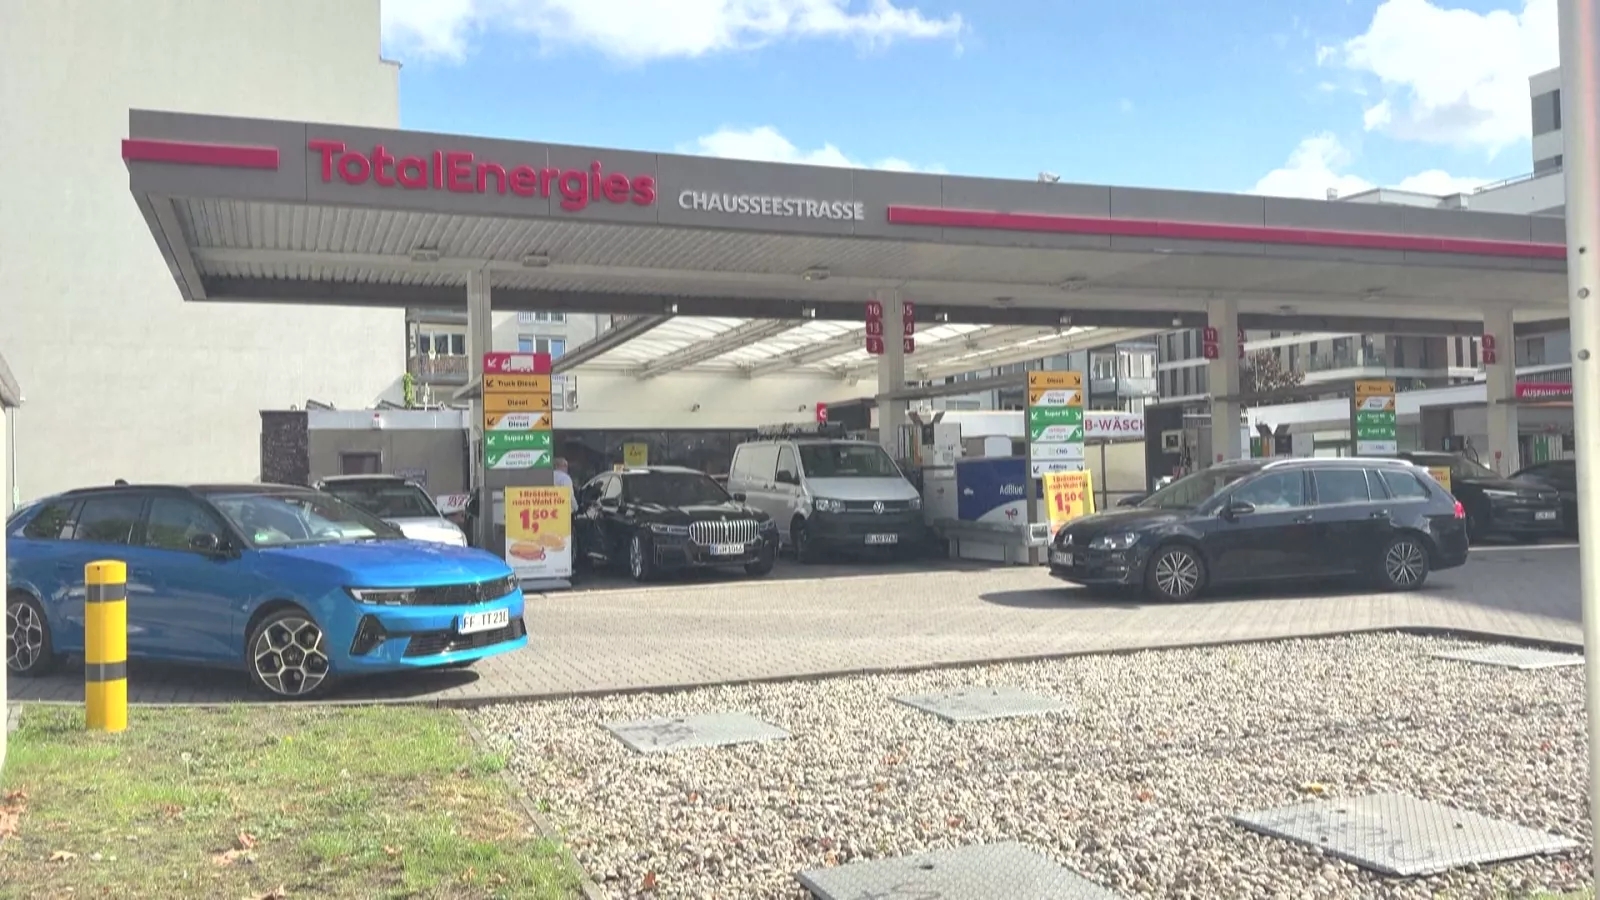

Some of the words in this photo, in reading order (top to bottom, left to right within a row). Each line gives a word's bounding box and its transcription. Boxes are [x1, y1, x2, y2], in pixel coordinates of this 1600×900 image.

[309, 140, 655, 211] TotalEnergies
[678, 190, 865, 220] CHAUSSEESTRASSE
[1044, 410, 1061, 418] Super
[503, 434, 524, 442] Super
[523, 489, 559, 497] Brötchen
[999, 484, 1023, 496] AdBlue
[512, 498, 531, 506] nach
[463, 615, 475, 629] FF
[482, 612, 492, 626] TT
